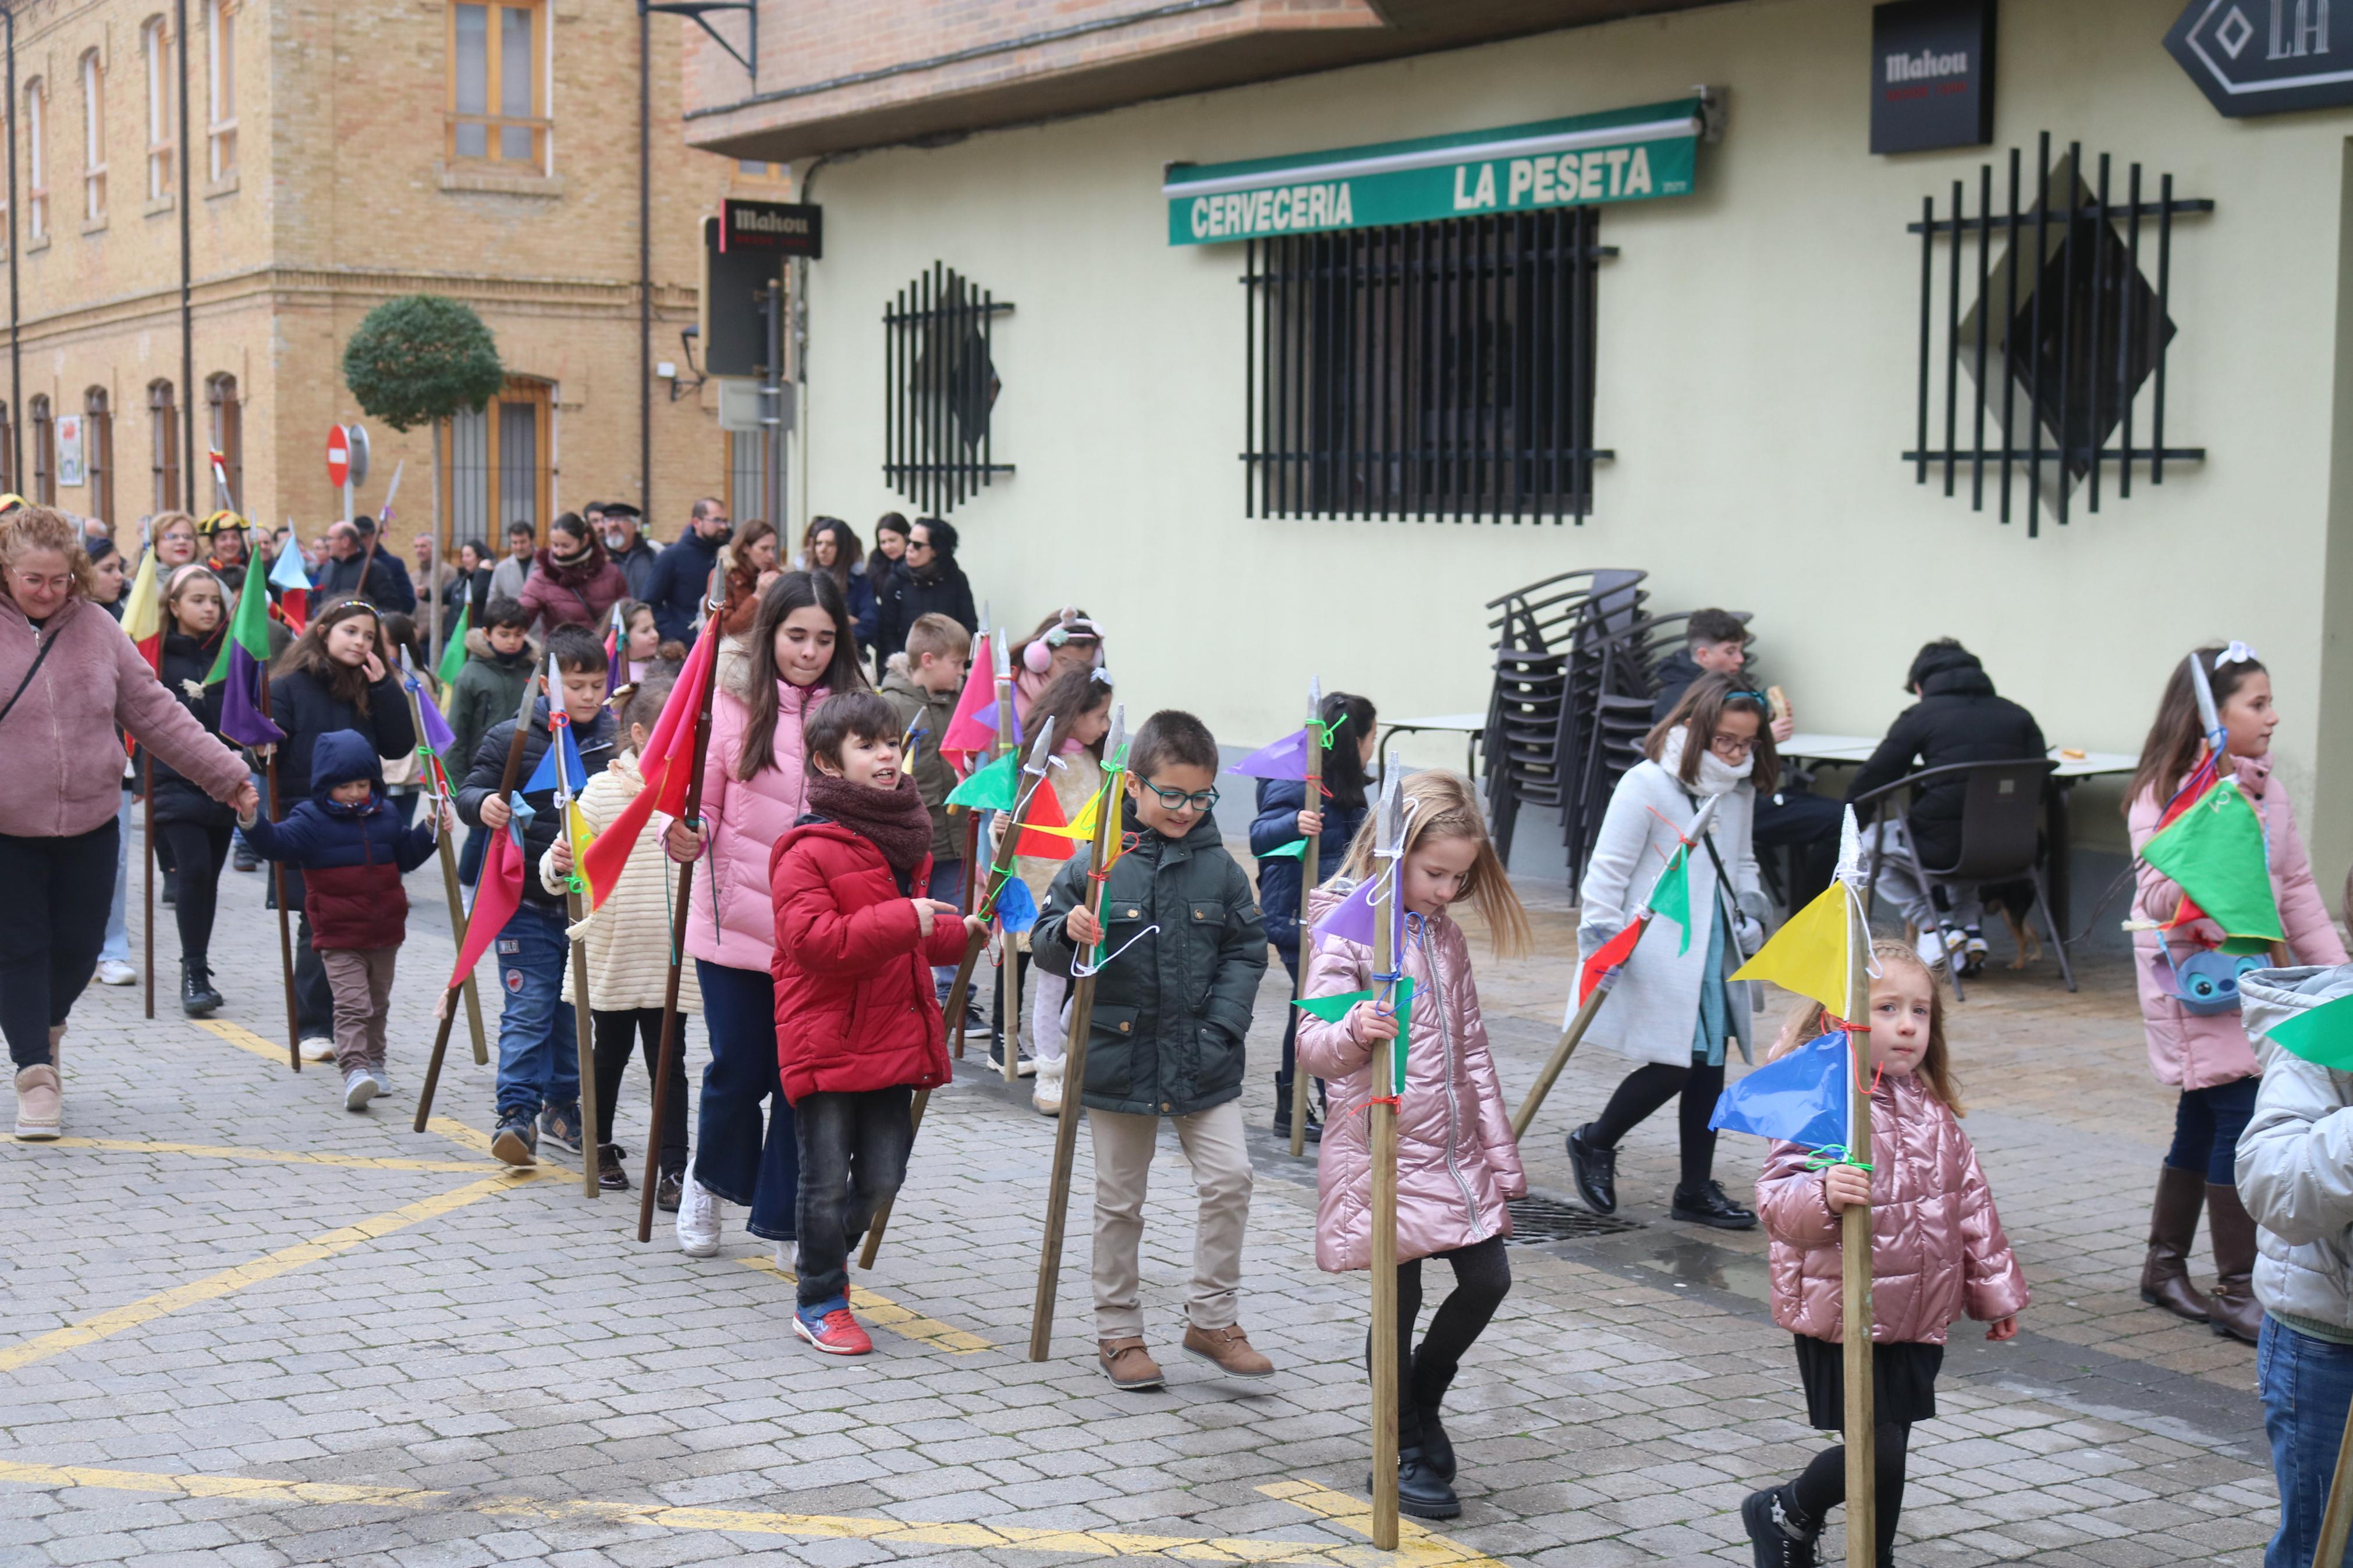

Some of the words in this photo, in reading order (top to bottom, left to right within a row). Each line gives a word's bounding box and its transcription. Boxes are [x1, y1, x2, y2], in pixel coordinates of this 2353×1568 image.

[2266, 0, 2330, 60] LA
[1886, 49, 1967, 83] Mahou
[1191, 182, 1353, 239] CERVECERIA
[1453, 163, 1497, 210] LA
[1507, 147, 1652, 206] PESETA
[734, 208, 809, 234] Mahou
